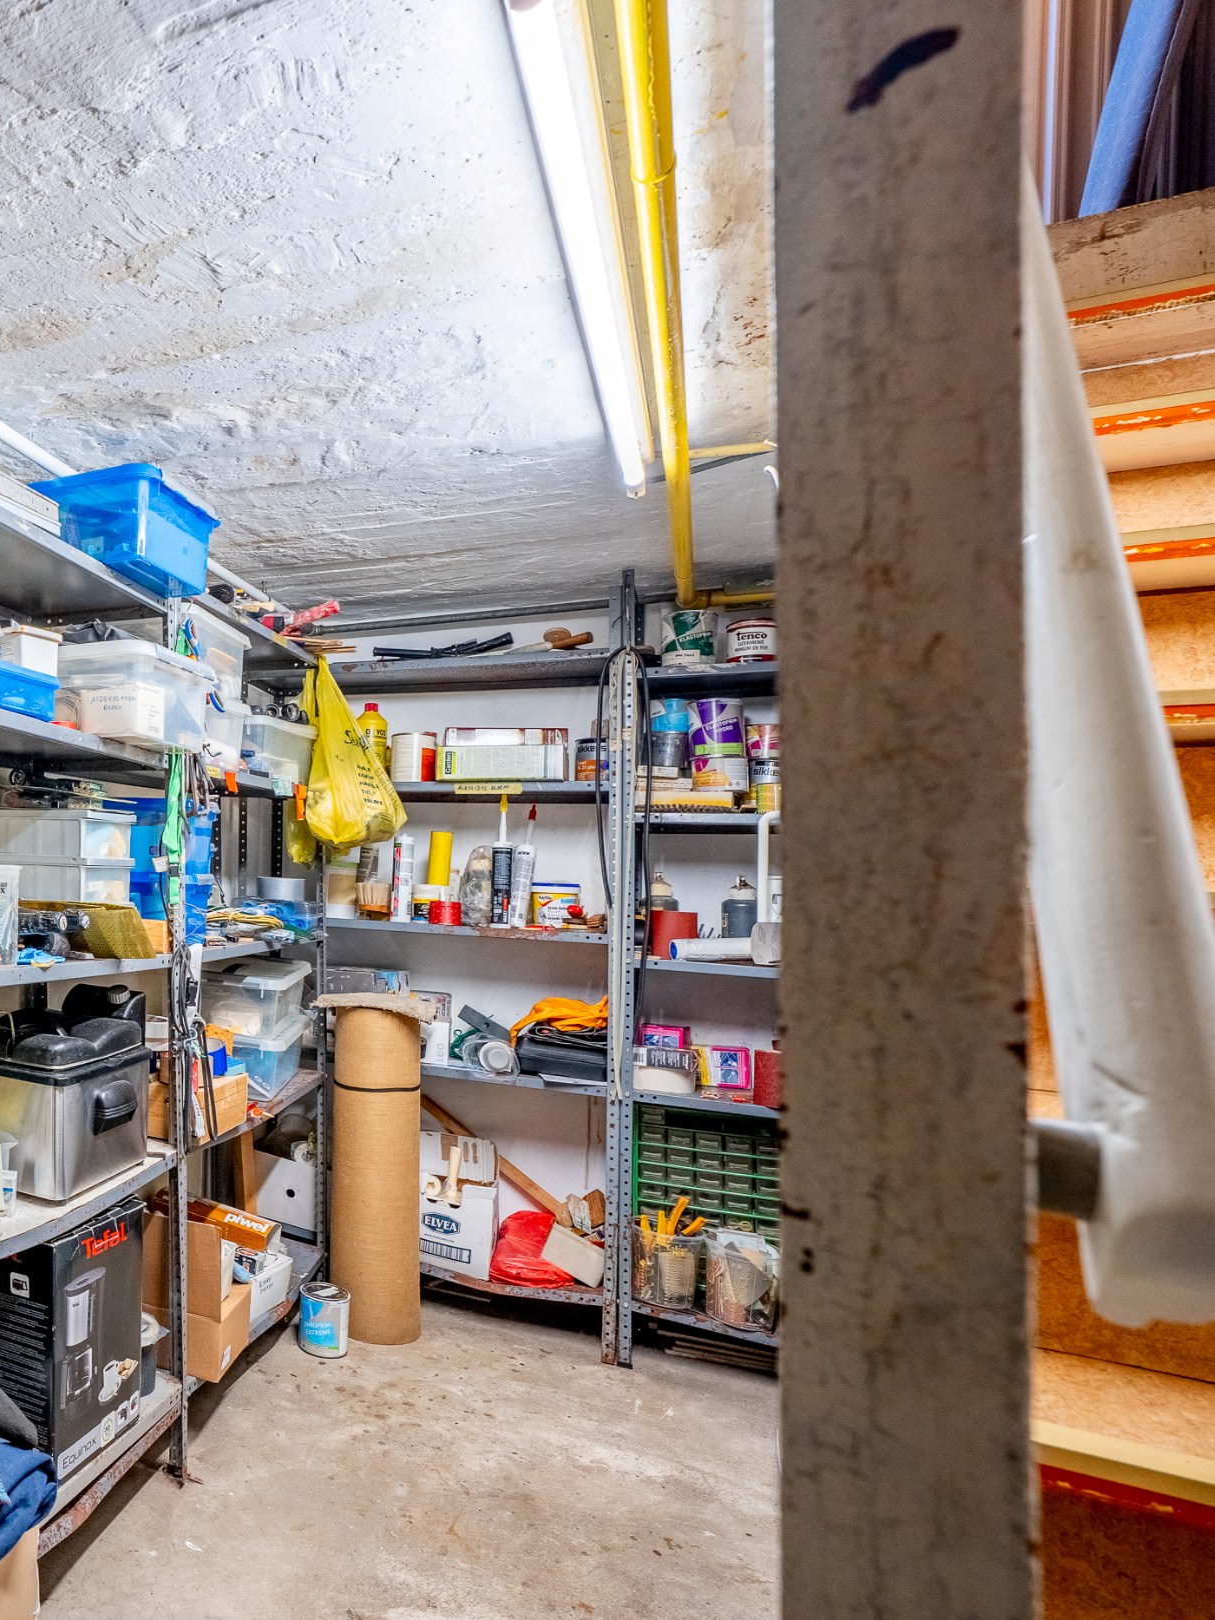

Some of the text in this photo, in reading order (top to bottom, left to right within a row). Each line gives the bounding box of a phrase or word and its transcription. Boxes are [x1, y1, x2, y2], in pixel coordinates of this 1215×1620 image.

[735, 630, 768, 641] tenco
[577, 744, 607, 752] ikkes
[753, 767, 780, 777] sikke
[224, 1212, 271, 1233] piwel
[424, 1215, 457, 1232] ELVEA
[81, 1221, 128, 1260] Tefal
[62, 1435, 98, 1470] Equinox
